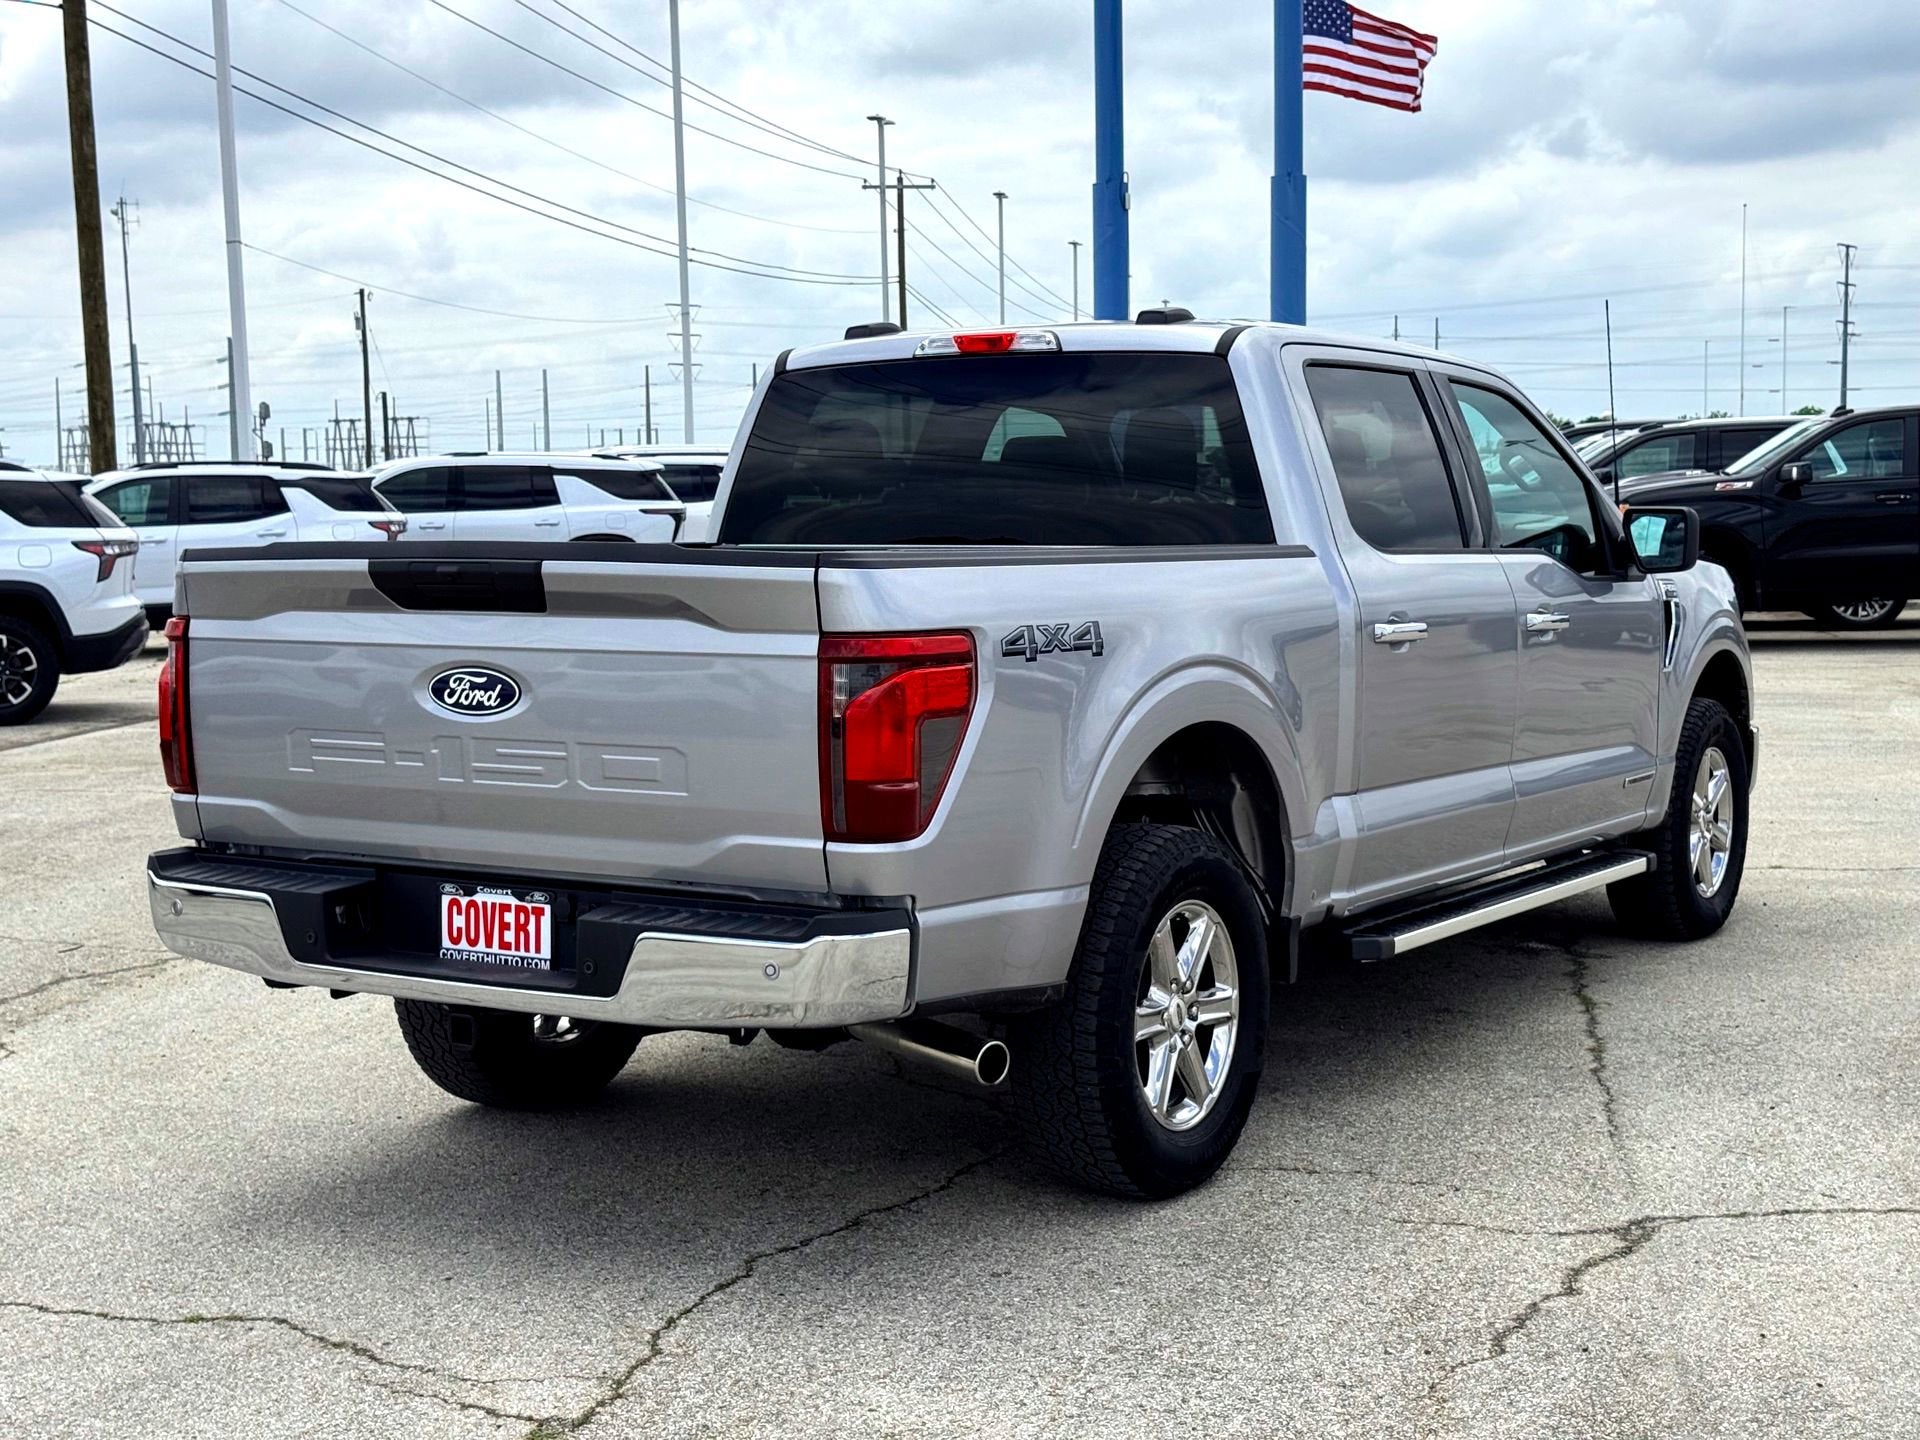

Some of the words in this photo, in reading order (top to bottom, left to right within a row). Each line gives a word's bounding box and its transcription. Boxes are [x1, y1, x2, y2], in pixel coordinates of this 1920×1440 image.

[444, 673, 502, 707] Ford
[287, 728, 689, 797] F-150
[477, 886, 512, 896] Covert
[447, 897, 545, 955] COVERT
[440, 949, 550, 970] COVERTHUTTOCOM
